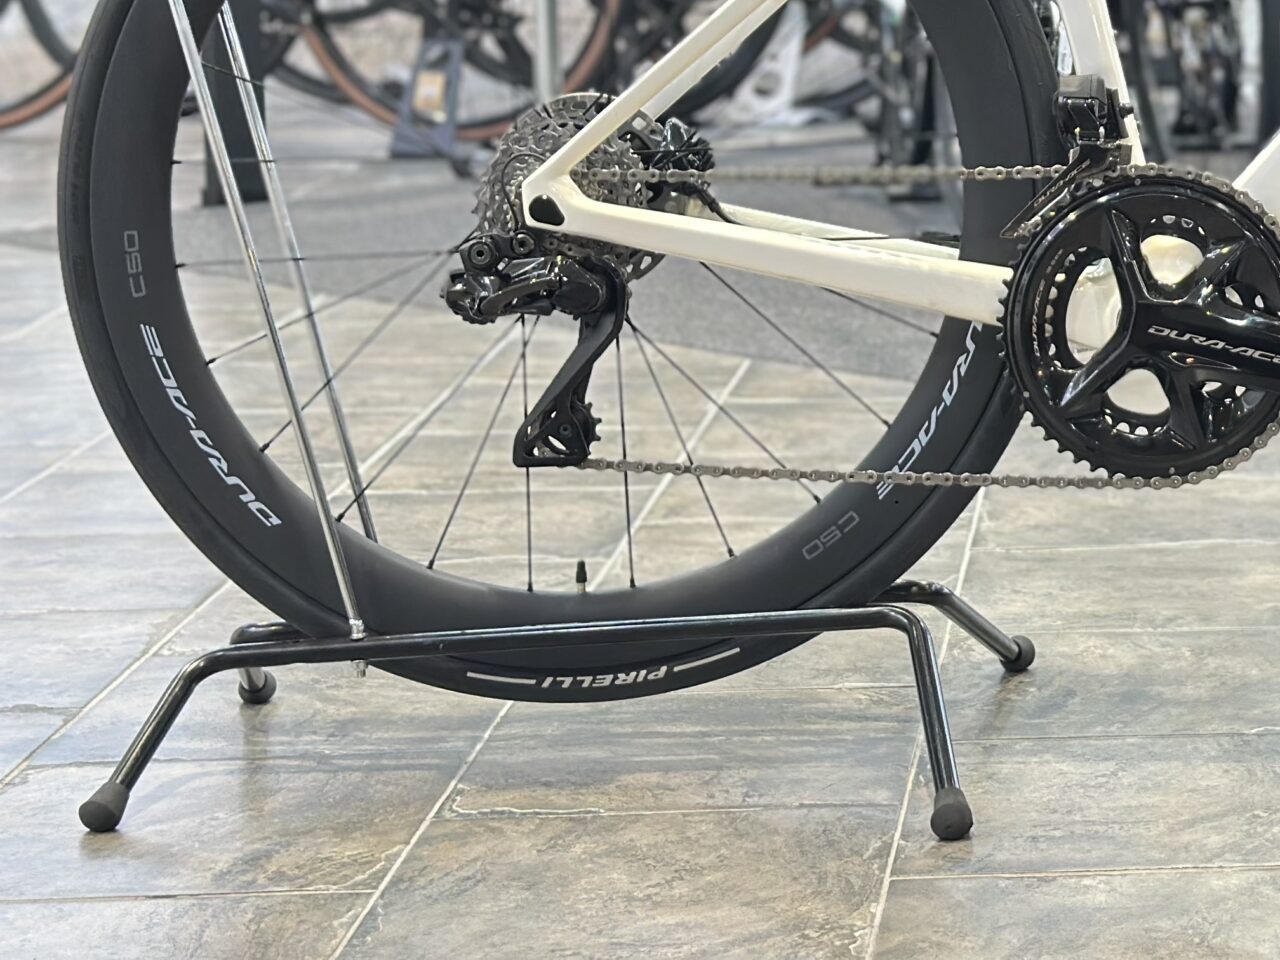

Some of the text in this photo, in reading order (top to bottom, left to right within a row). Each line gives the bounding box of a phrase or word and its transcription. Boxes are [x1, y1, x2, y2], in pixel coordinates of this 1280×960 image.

[123, 229, 147, 298] C50
[140, 323, 283, 528] DURA-ACE
[802, 320, 983, 561] URA-ACE C50
[541, 665, 668, 689] PIRELLI
